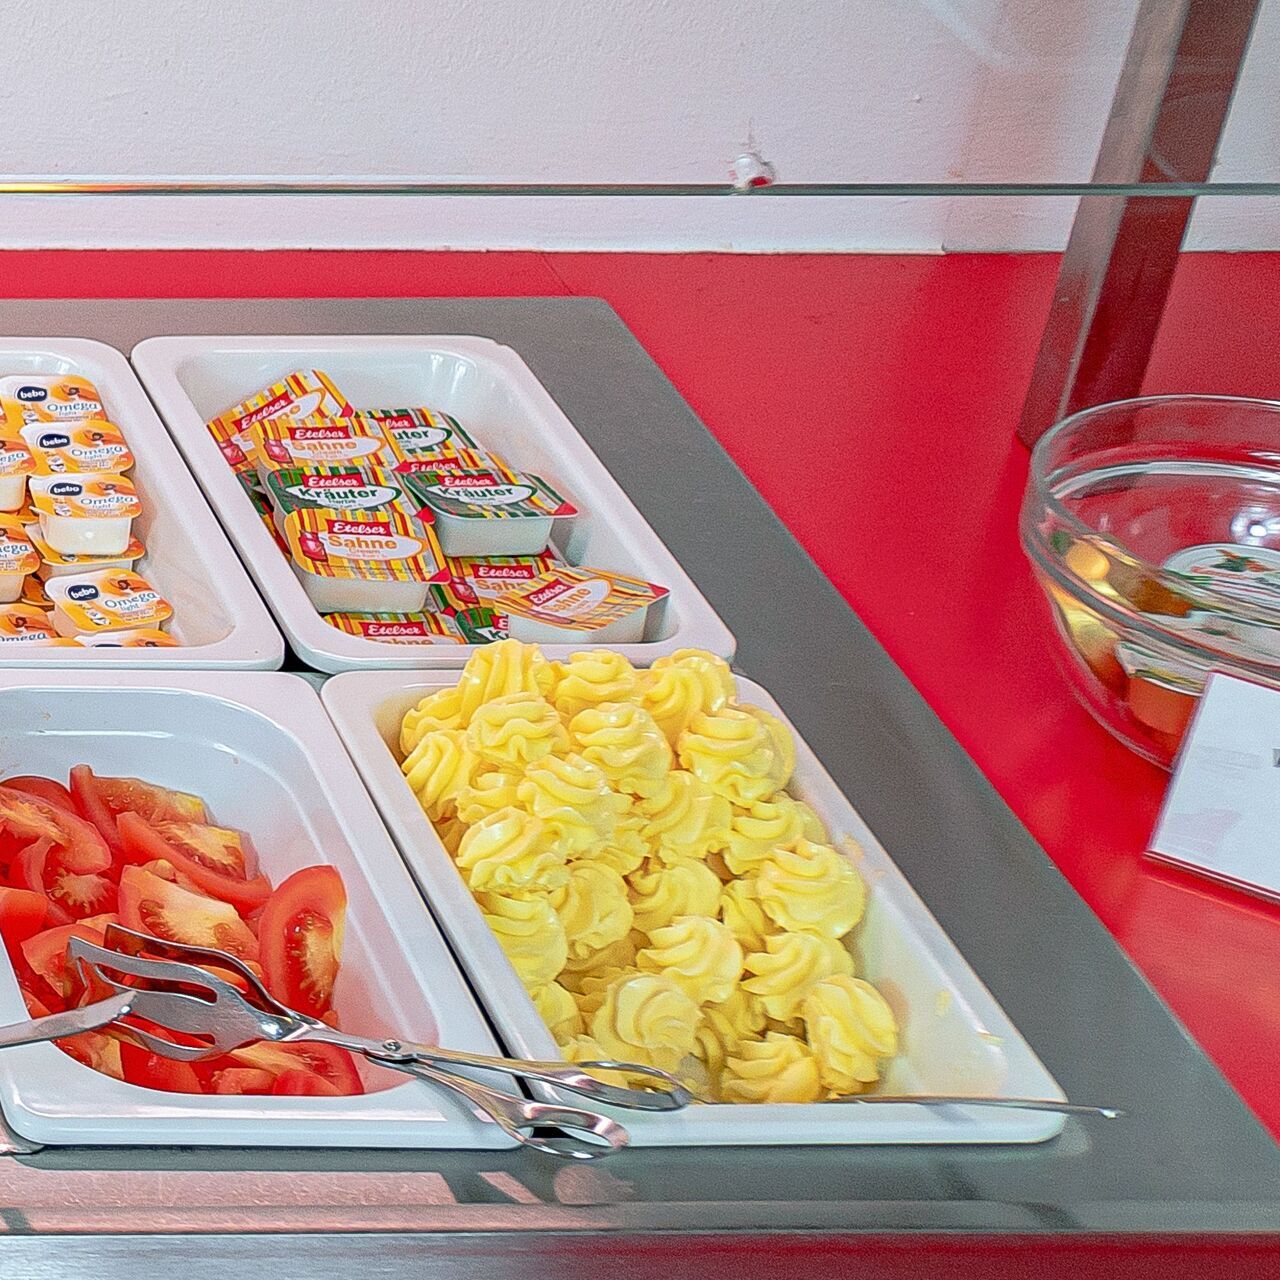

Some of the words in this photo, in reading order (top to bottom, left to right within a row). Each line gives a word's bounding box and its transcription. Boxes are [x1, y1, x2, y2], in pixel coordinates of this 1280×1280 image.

[20, 389, 45, 398] bebo
[47, 402, 98, 413] Omega
[294, 430, 346, 439] Etelser
[43, 437, 68, 446] bebo
[292, 441, 357, 452] Sahne
[72, 446, 124, 456] Omega
[308, 478, 359, 487] Etelser
[444, 476, 492, 486] Etelser
[54, 485, 79, 493] bebo
[298, 488, 378, 500] Kräuter
[439, 486, 513, 498] Kräuter
[80, 496, 134, 505] Omega
[332, 522, 386, 534] Etelser
[328, 535, 397, 550] Sahne
[478, 567, 530, 578] Etelser
[70, 588, 96, 599] bebo
[104, 592, 157, 608] Omega
[368, 625, 421, 634] Etelser
